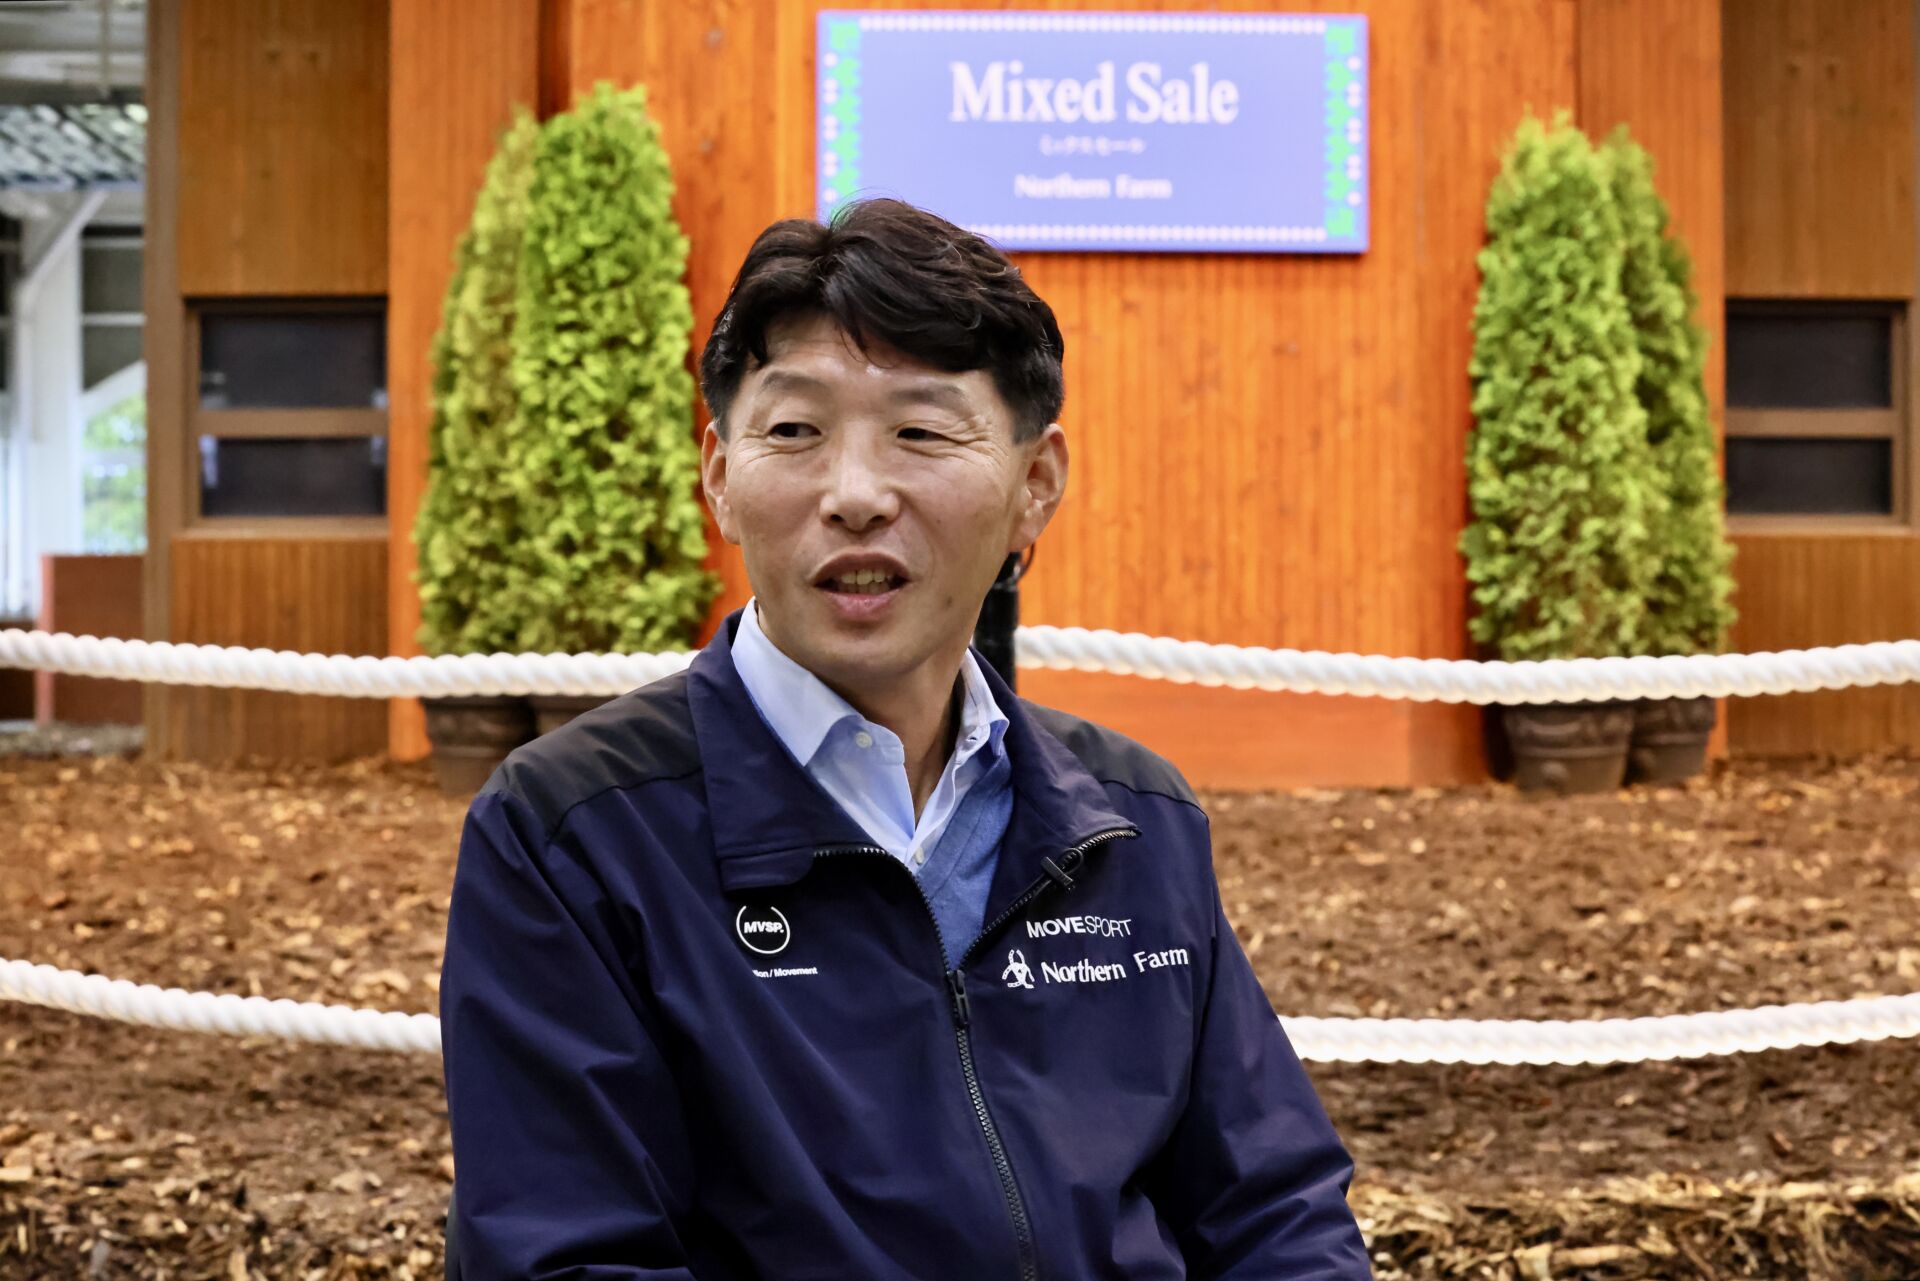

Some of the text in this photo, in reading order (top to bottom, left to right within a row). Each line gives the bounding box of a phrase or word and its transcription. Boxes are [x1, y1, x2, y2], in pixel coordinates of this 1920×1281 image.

[949, 60, 1239, 124] Mixed Sale
[1014, 174, 1172, 198] Northern Farm
[1026, 915, 1131, 938] MOVESPORT
[774, 966, 818, 977] Movement
[1041, 948, 1189, 984] Northern Farm
